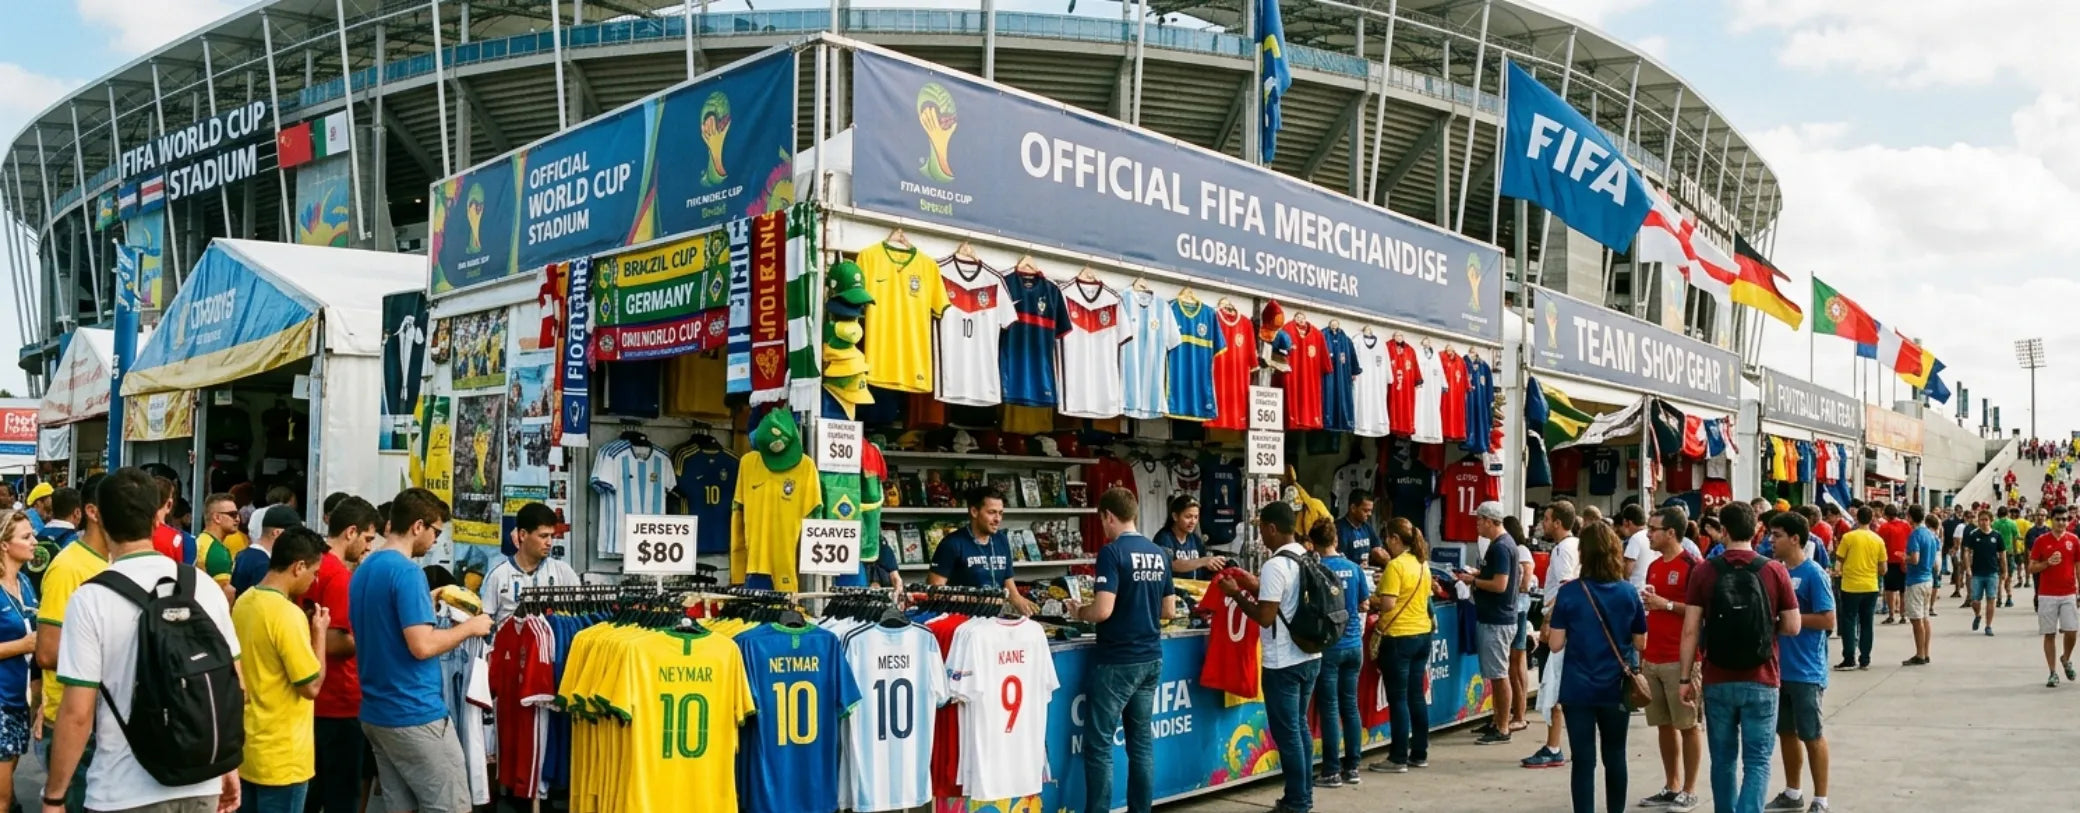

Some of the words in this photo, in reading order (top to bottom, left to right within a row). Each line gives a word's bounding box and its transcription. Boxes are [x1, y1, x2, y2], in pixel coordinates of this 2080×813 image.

[122, 145, 155, 179] FIFA
[158, 117, 222, 165] WORLD
[227, 101, 266, 139] CUP
[170, 144, 257, 200] STADIUM
[529, 151, 590, 189] OFFICIAL
[1526, 112, 1629, 207] FIFA
[528, 180, 588, 220] WORLD
[593, 163, 631, 199] CUP
[1020, 131, 1190, 215] OFFICIAL
[1201, 180, 1265, 236] FIFA
[1275, 202, 1448, 286] MERCHANDISE
[528, 209, 590, 246] STADIUM
[672, 246, 698, 268] CUP
[1177, 233, 1250, 273] GLOBAL
[1255, 251, 1359, 297] SPORTSWEAR
[625, 281, 694, 315] GERMANY
[679, 320, 702, 342] CUP
[962, 318, 973, 338] 10
[1573, 316, 1636, 374] TEAM
[1642, 337, 1684, 384] SHOP
[1687, 352, 1721, 394] GEAR
[1256, 452, 1276, 467] $30
[704, 485, 721, 505] 10
[633, 522, 690, 536] JERSEYS
[806, 527, 857, 539] SCARVES
[637, 539, 684, 565] $80
[811, 542, 849, 564] $30
[659, 666, 713, 683] NEYMAR
[769, 656, 819, 674] NEYMAR
[878, 654, 911, 670] MESSI
[998, 650, 1025, 665] KANE
[773, 680, 819, 746] 10
[872, 677, 914, 741] 10
[1001, 675, 1023, 733] 9
[1152, 679, 1192, 715] IFA
[660, 693, 709, 759] 10
